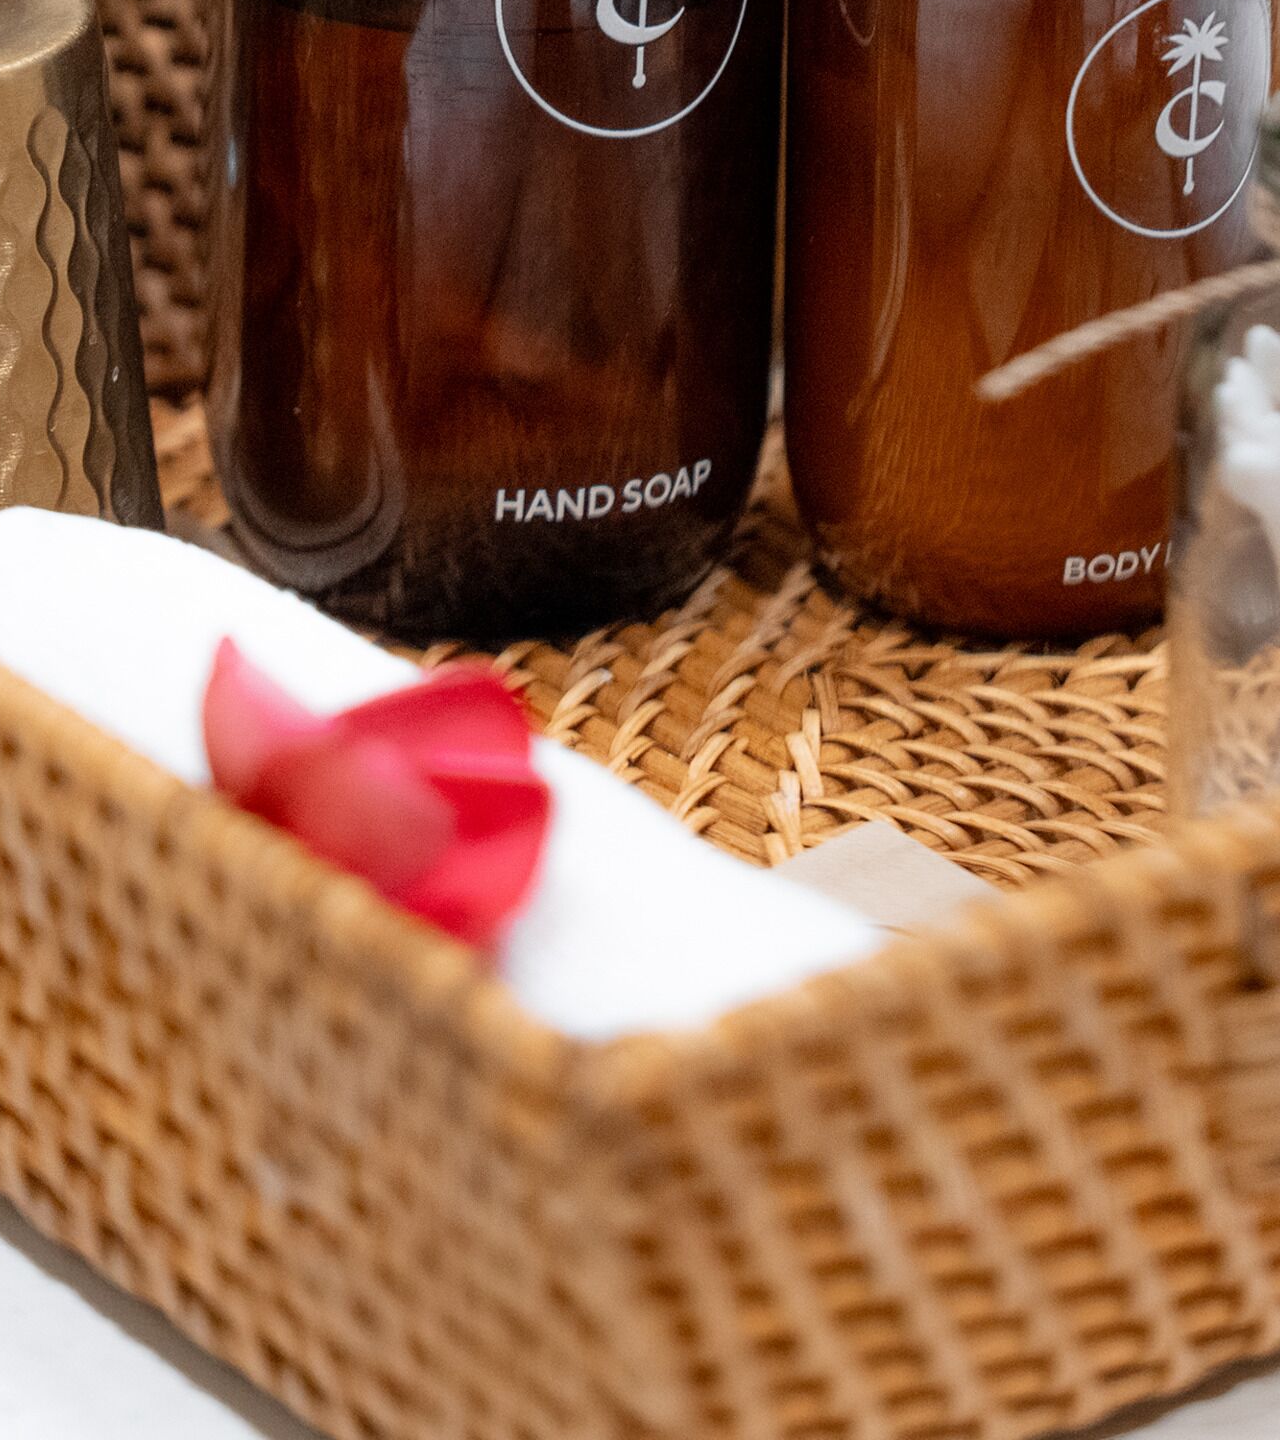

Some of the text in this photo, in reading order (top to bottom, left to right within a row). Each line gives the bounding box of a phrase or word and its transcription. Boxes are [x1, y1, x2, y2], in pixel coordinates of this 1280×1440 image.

[495, 459, 712, 522] HAND SOAP
[1062, 542, 1160, 585] BODY
